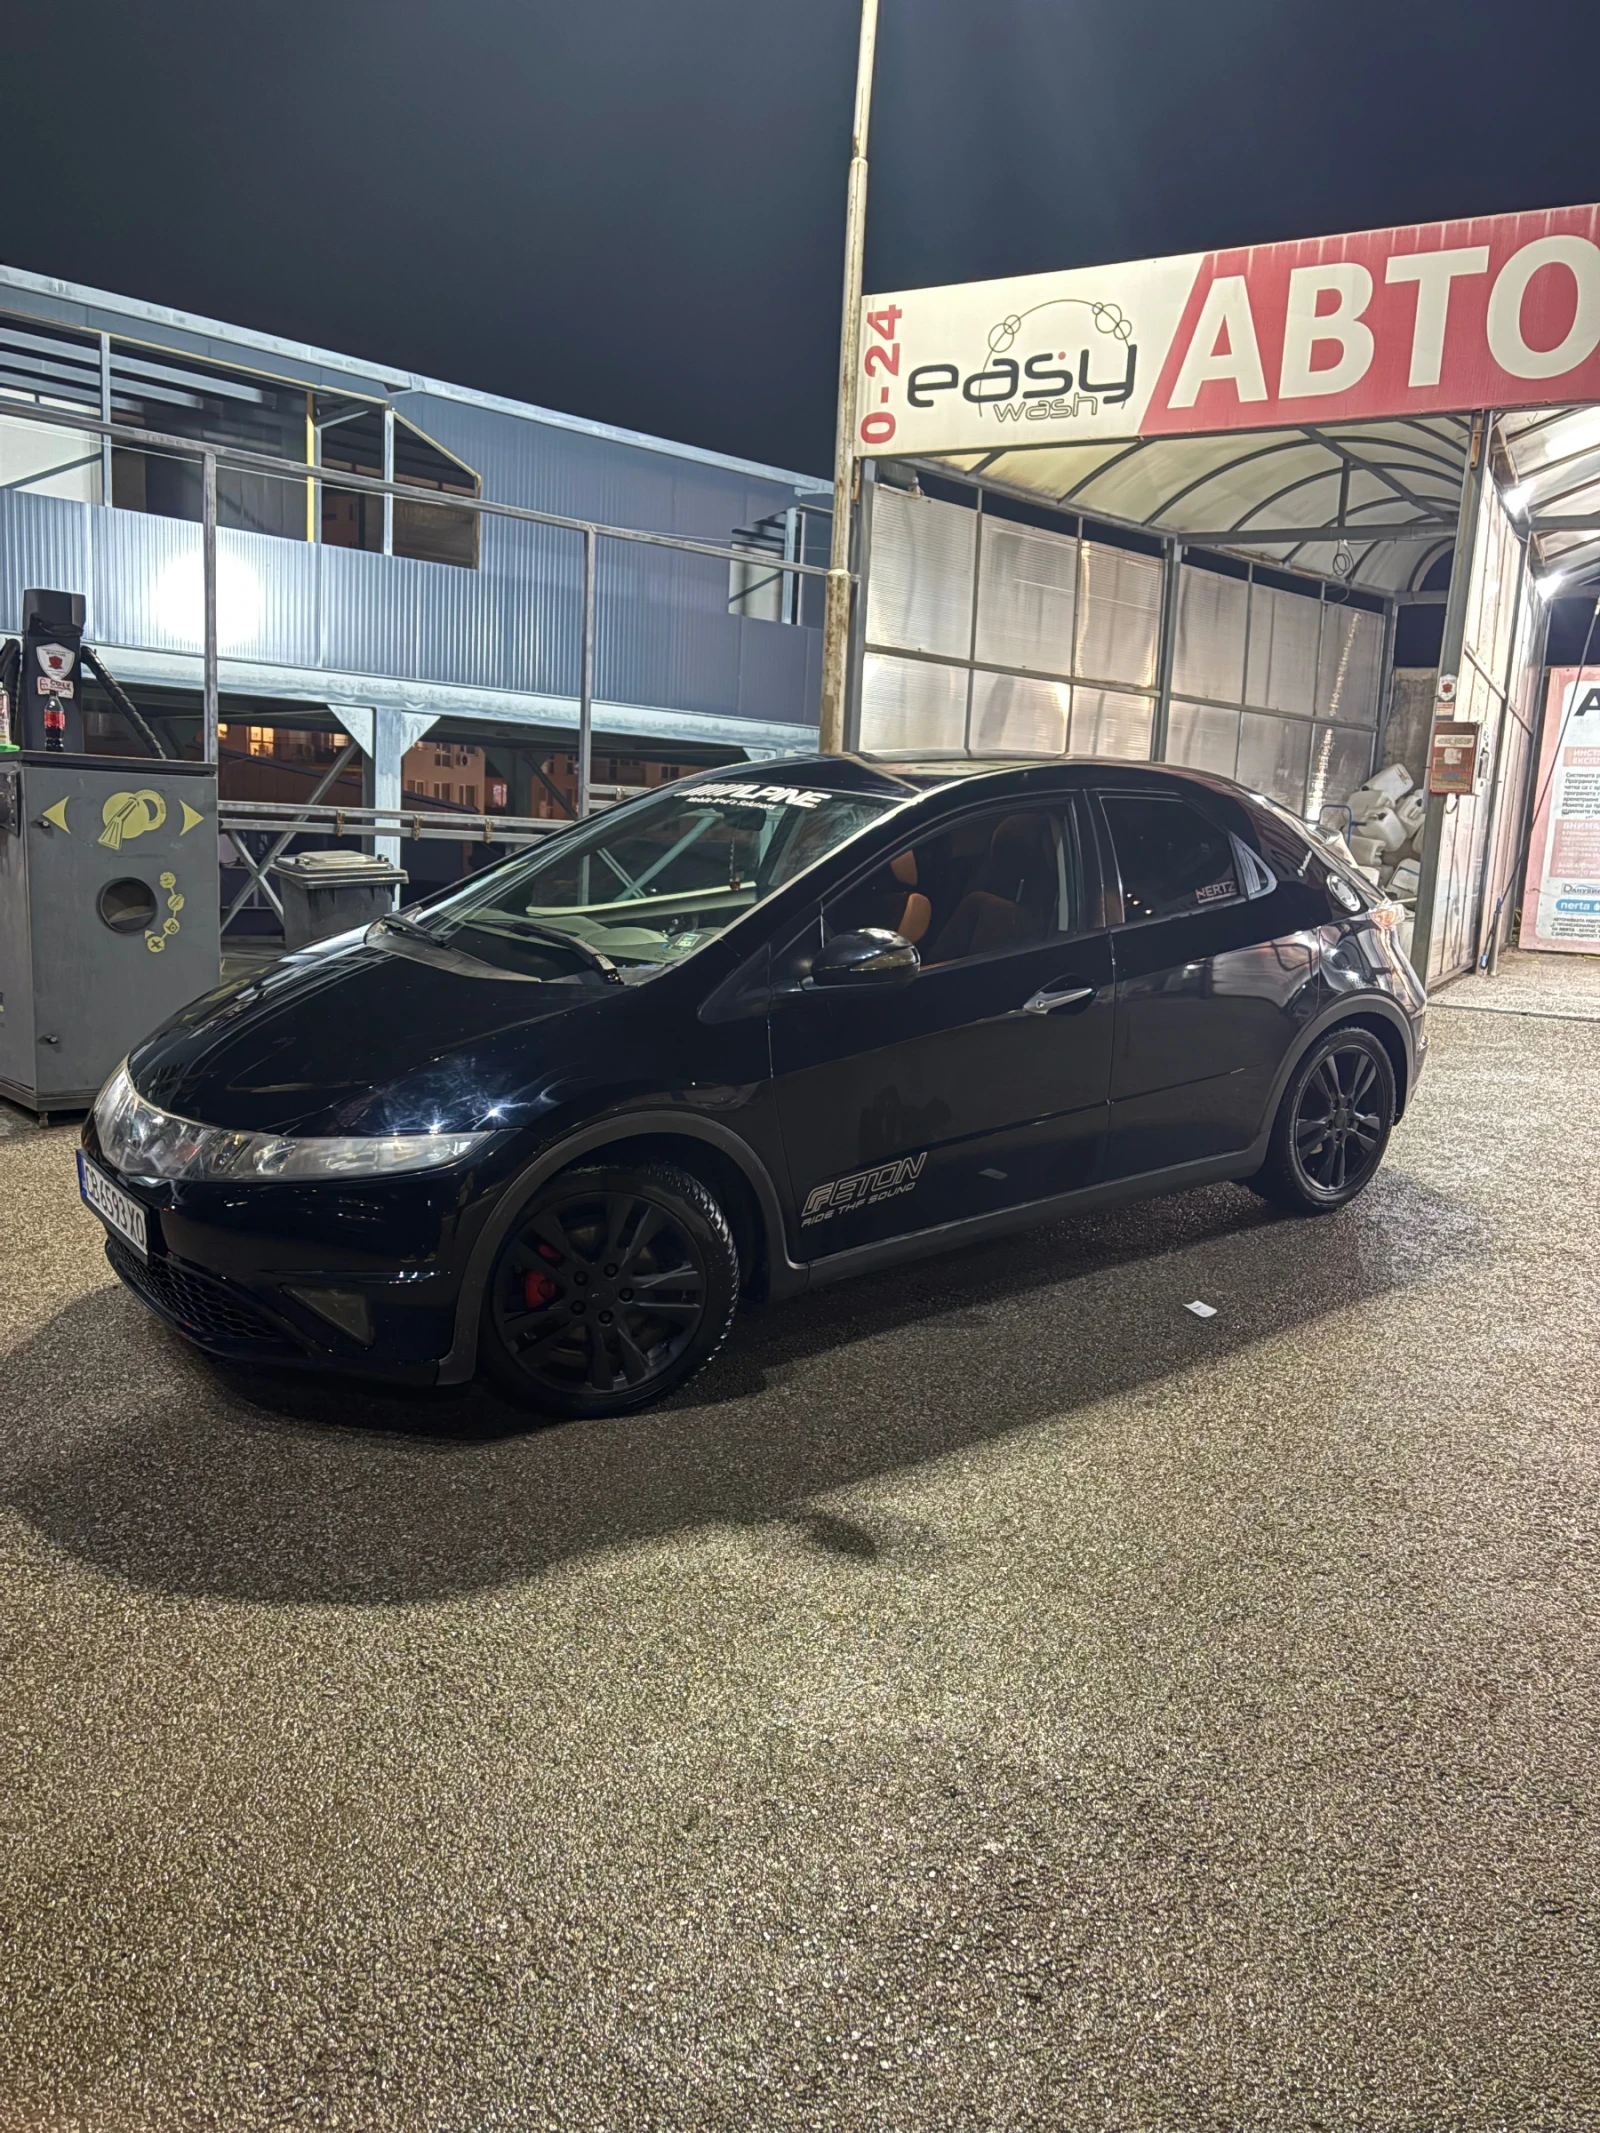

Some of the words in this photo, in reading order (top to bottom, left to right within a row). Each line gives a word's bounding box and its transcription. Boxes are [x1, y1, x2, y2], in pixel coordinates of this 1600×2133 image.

[1167, 235, 1600, 409] АВТО
[907, 344, 1137, 408] easy
[993, 392, 1098, 422] wash
[1560, 902, 1590, 911] nerta
[801, 1152, 928, 1217] FETON
[801, 1209, 835, 1228] RIDE
[867, 1182, 916, 1205] SOUND
